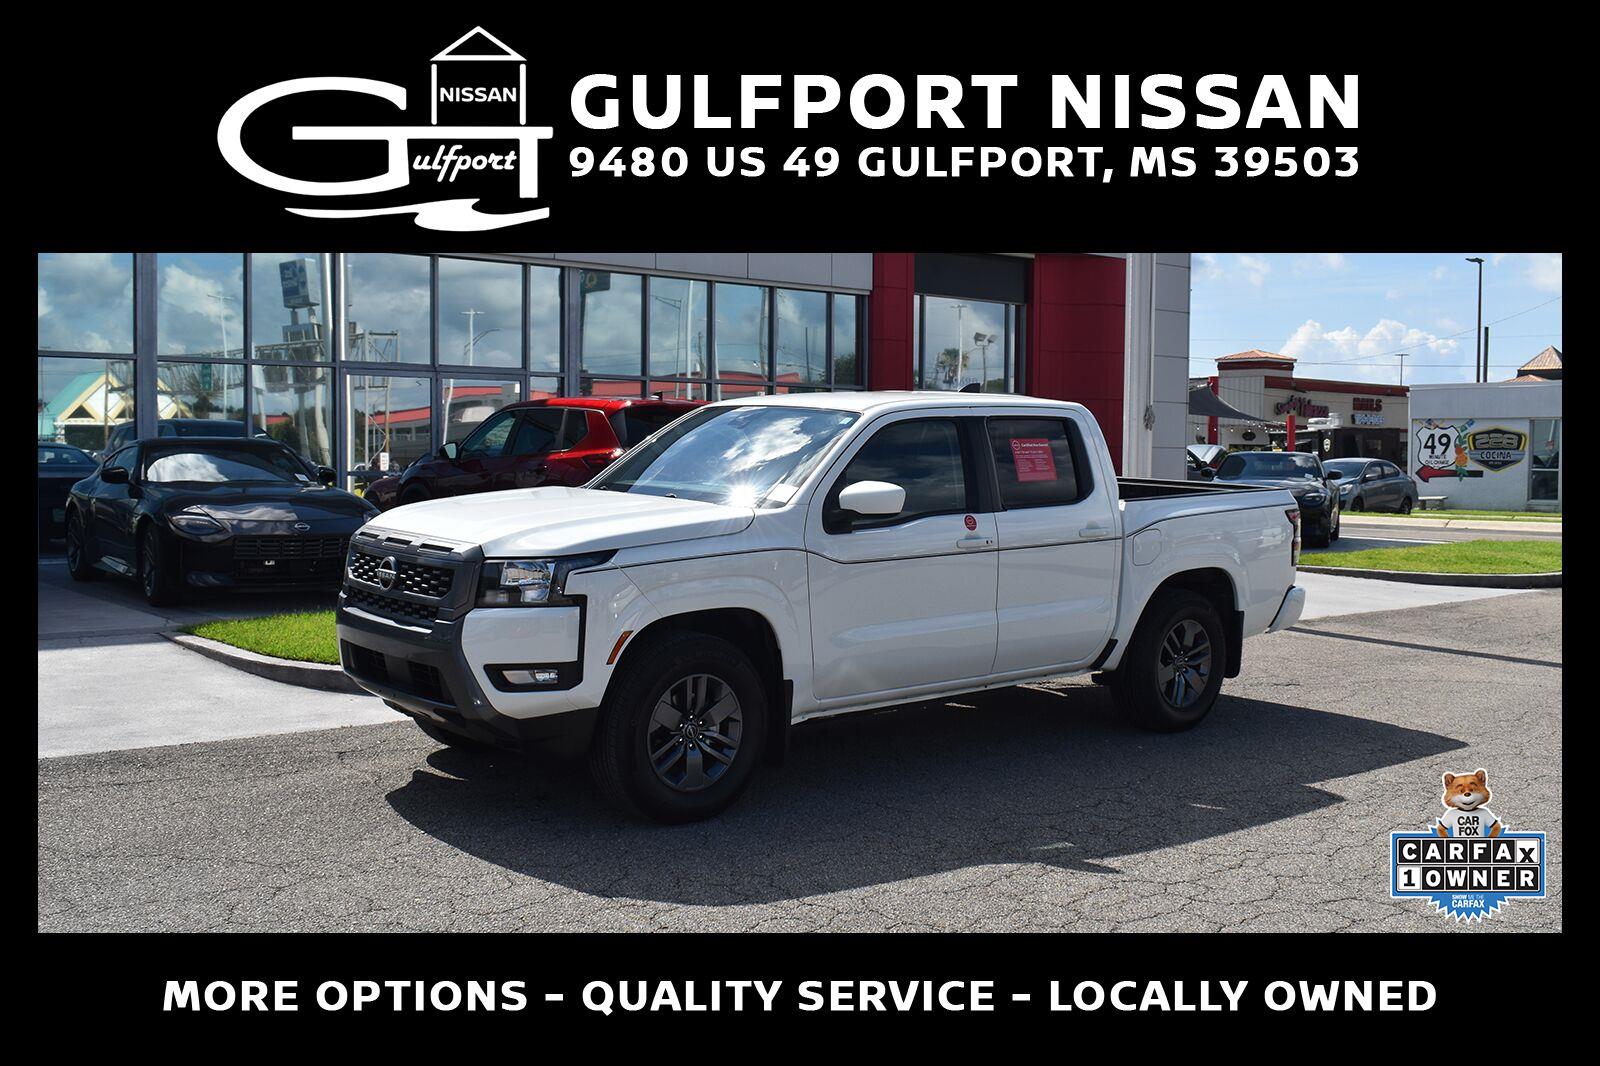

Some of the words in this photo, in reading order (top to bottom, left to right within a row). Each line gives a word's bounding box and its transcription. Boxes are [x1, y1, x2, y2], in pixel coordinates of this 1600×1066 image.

[1423, 433, 1451, 455] 49
[1475, 433, 1519, 449] 228
[1480, 451, 1512, 460] COCINA
